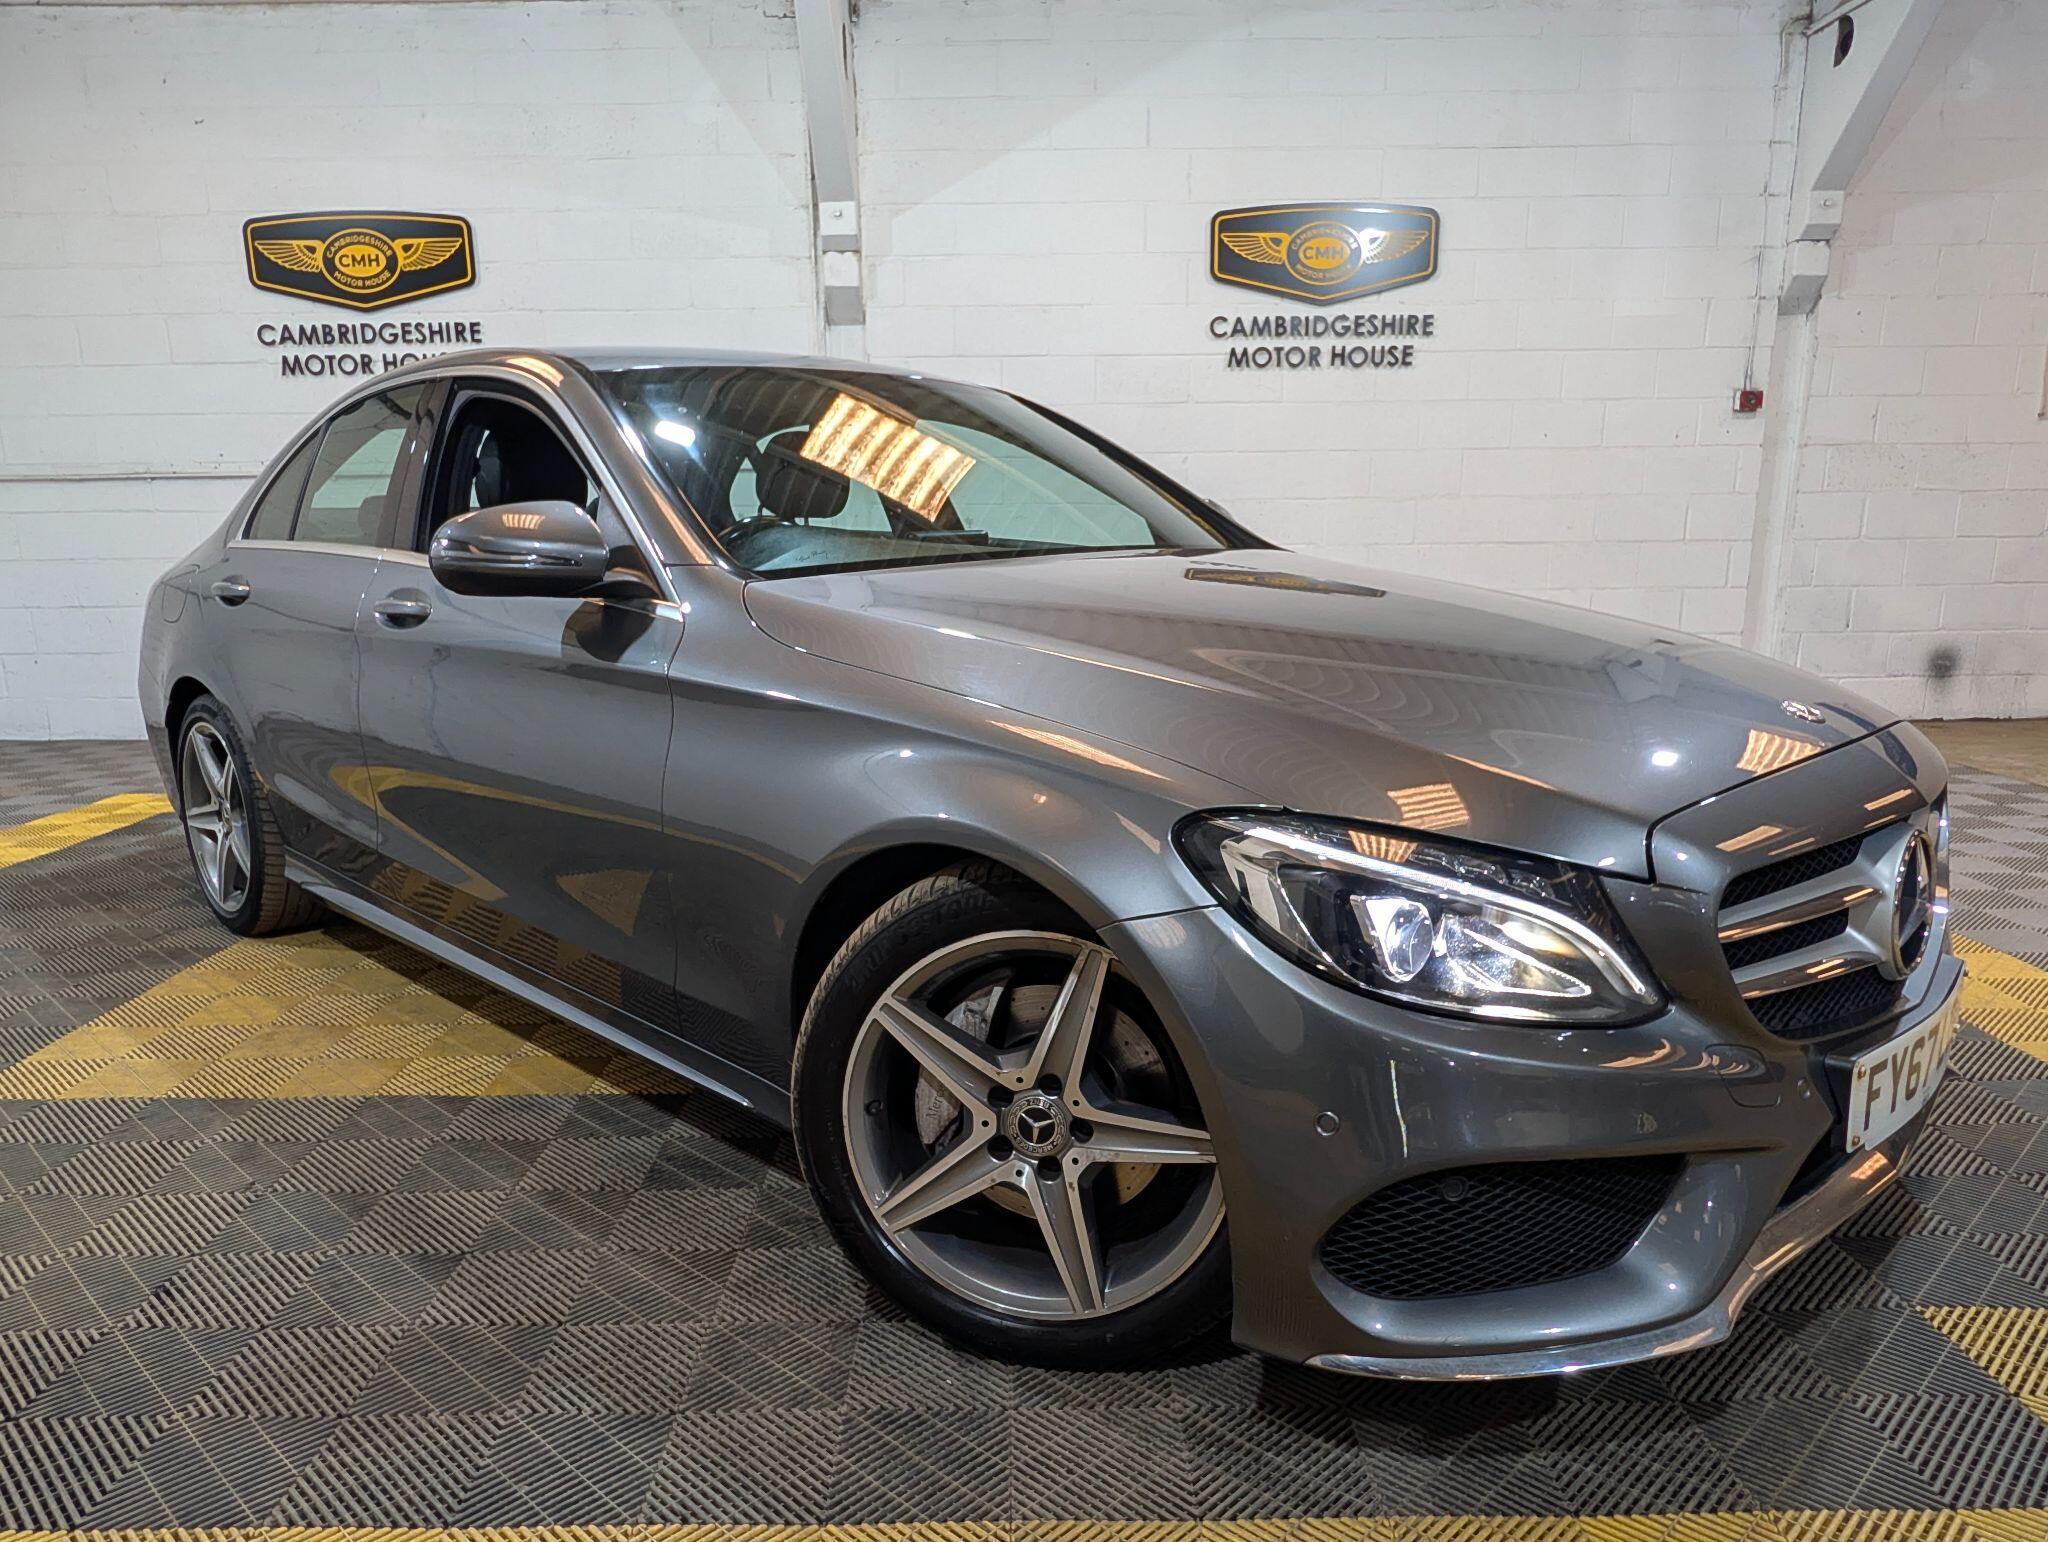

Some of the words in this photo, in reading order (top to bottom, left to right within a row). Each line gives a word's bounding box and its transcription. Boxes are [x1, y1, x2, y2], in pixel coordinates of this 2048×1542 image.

[327, 235, 393, 258] CAMBRIDGESHIRE
[1303, 246, 1344, 260] CMH
[338, 253, 380, 268] CMH
[333, 270, 363, 287] MOTOR
[364, 269, 391, 287] HOUSE
[257, 321, 483, 346] CAMBRIDGESHIRE
[1210, 314, 1435, 338] CAMBRIDGESHIRE
[281, 354, 375, 376] MOTOR
[1228, 346, 1321, 368] MOTOR
[1330, 345, 1414, 367] HOUSE
[1864, 1020, 1942, 1132] FY67
